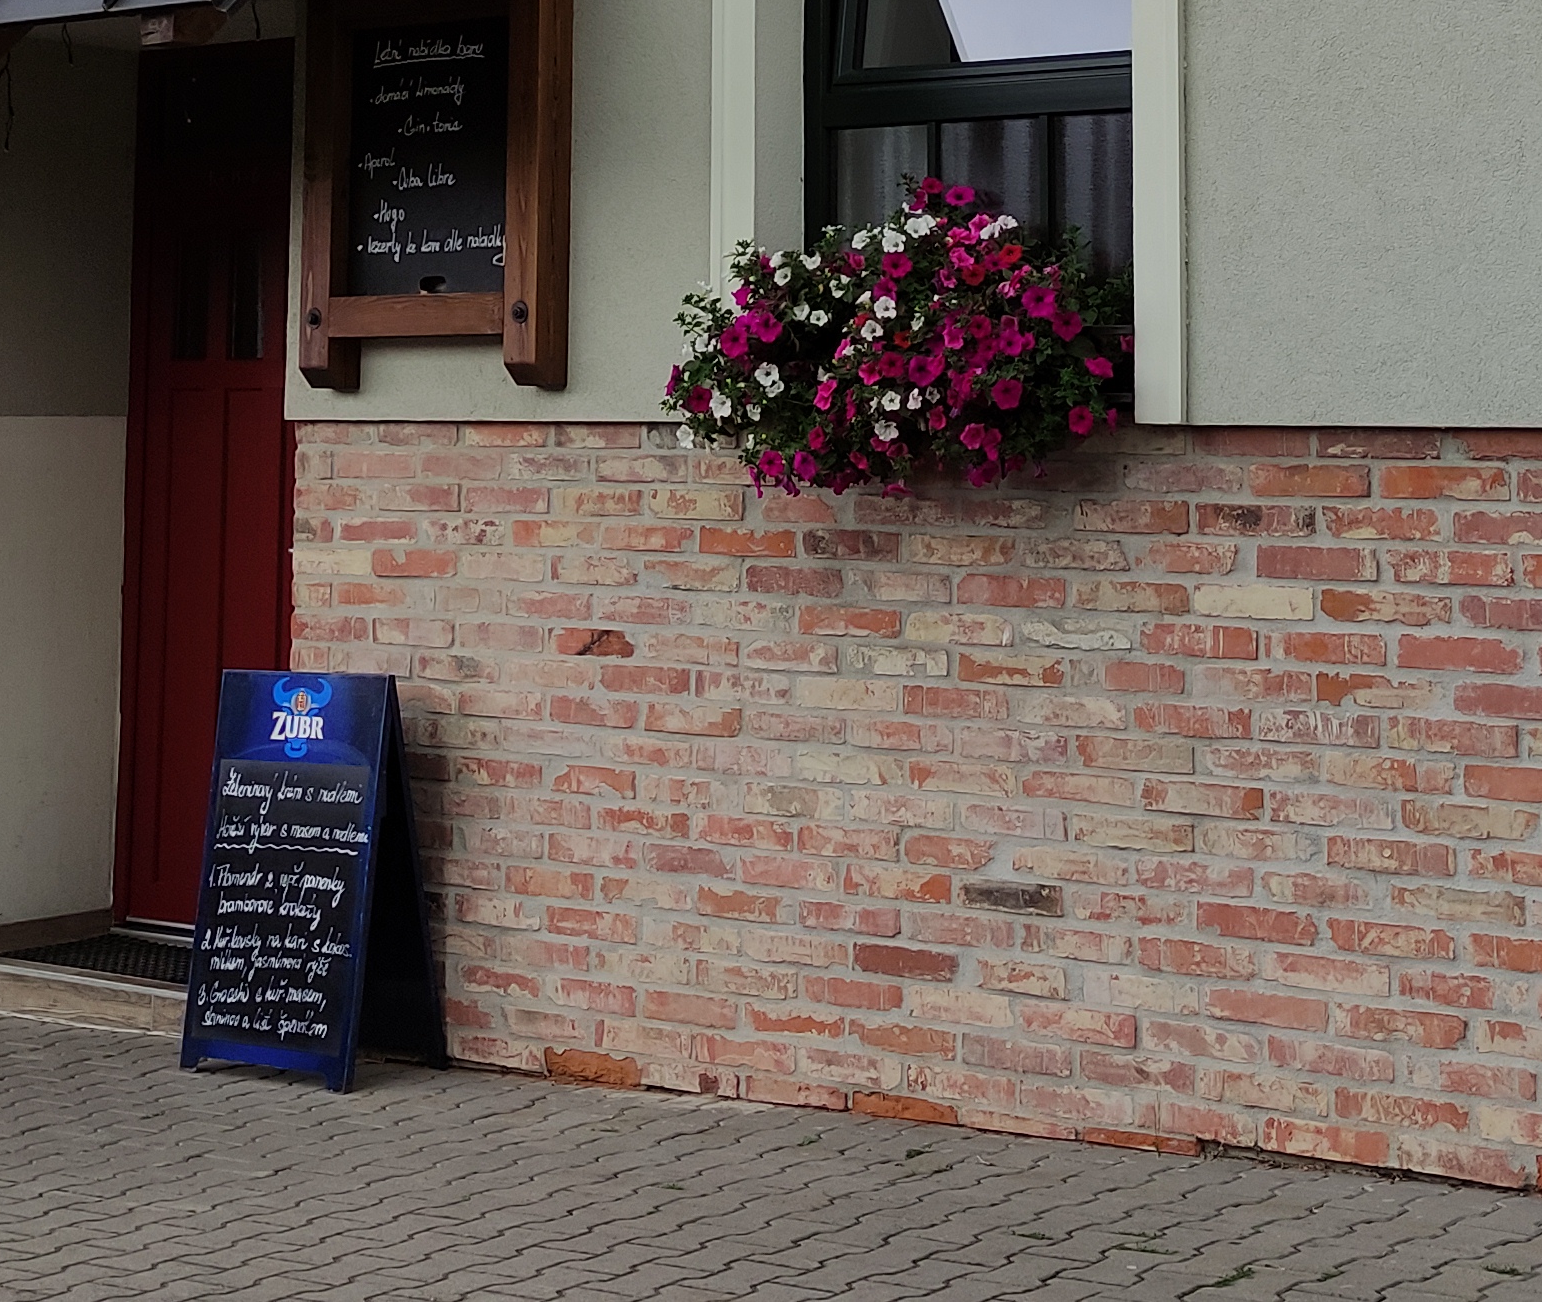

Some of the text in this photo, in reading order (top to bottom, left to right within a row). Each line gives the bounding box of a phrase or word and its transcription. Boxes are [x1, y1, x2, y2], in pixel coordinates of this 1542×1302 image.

[270, 711, 324, 741] ZUBR
[305, 787, 315, 801] s
[279, 824, 288, 837] s
[322, 827, 330, 840] a
[311, 938, 321, 953] s
[242, 1015, 251, 1029] a
